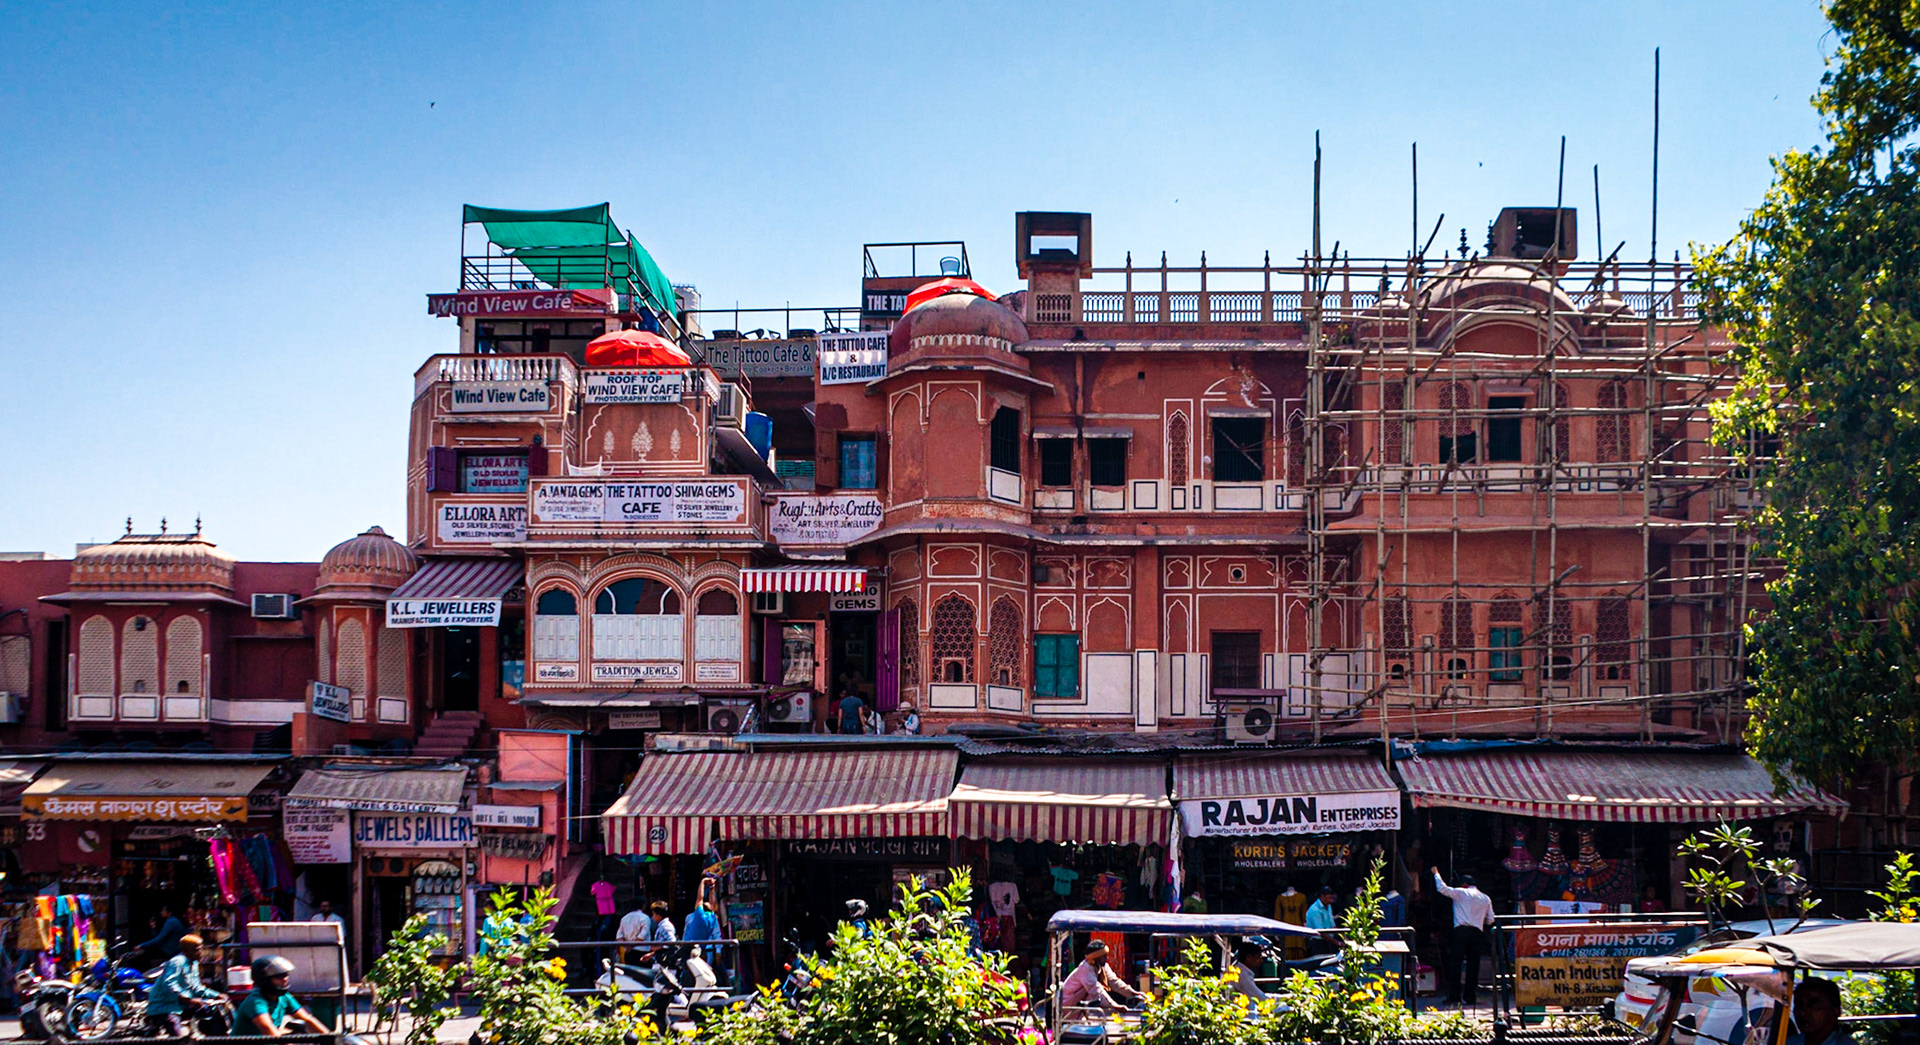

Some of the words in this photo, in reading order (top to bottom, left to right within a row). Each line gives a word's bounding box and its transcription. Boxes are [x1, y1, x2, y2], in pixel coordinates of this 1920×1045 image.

[432, 297, 478, 314] Wind
[483, 296, 526, 313] View
[867, 295, 888, 311] THE
[822, 338, 836, 352] THE
[838, 338, 866, 352] TATTOO
[867, 336, 886, 350] CAFE
[707, 346, 729, 364] The
[732, 346, 770, 364] Tattoo
[773, 345, 798, 362] Cafe
[802, 344, 812, 361] &
[850, 354, 857, 363] &
[822, 366, 836, 380] A/C
[838, 364, 886, 379] RESTAURANT
[607, 375, 637, 384] ROOF
[640, 375, 662, 384] TOP
[455, 389, 483, 404] Wind
[486, 388, 516, 403] View
[519, 387, 546, 402] Cafe
[588, 384, 617, 396] WIND
[620, 384, 648, 395] VIEW
[649, 384, 680, 395] CAFE
[464, 457, 502, 468] ELLORA
[579, 486, 602, 498] GEMS
[606, 486, 625, 498] THE
[627, 486, 672, 498] TATTOO
[674, 485, 704, 498] SHIVA
[705, 485, 735, 498] GEMS
[444, 506, 496, 521] ELLORA
[499, 506, 526, 522] ART
[622, 502, 662, 514] CAFE
[703, 504, 733, 512] JEWELLERY
[815, 500, 840, 516] Arts
[845, 500, 882, 516] Crafts
[797, 520, 811, 528] ART
[840, 520, 875, 528] JEWELLERY
[391, 602, 416, 615] K.L.
[420, 602, 496, 614] JEWELLERS
[834, 599, 876, 609] GEMS
[595, 666, 640, 675] TRADITION
[642, 666, 678, 676] JEWELS
[100, 801, 152, 816] नागरा
[155, 800, 177, 818] शू
[346, 801, 390, 810] JEWELS
[392, 803, 437, 813] GALLERY
[1201, 797, 1318, 827] RAJAN
[1320, 806, 1398, 823] ENTERPRISES
[26, 823, 46, 840] 33
[356, 816, 412, 841] JEWELS
[415, 816, 474, 841] GALLERY
[651, 828, 665, 840] 29
[1234, 846, 1286, 858] KURTI'S
[1293, 844, 1350, 858] JACKETS
[1234, 860, 1286, 868] WHOLESALERS
[1297, 859, 1346, 867] WHOLESALERS
[1537, 933, 1581, 947] थाना
[1584, 933, 1634, 947] माणक
[1634, 929, 1676, 946] चौक
[1521, 966, 1565, 980] Ratan
